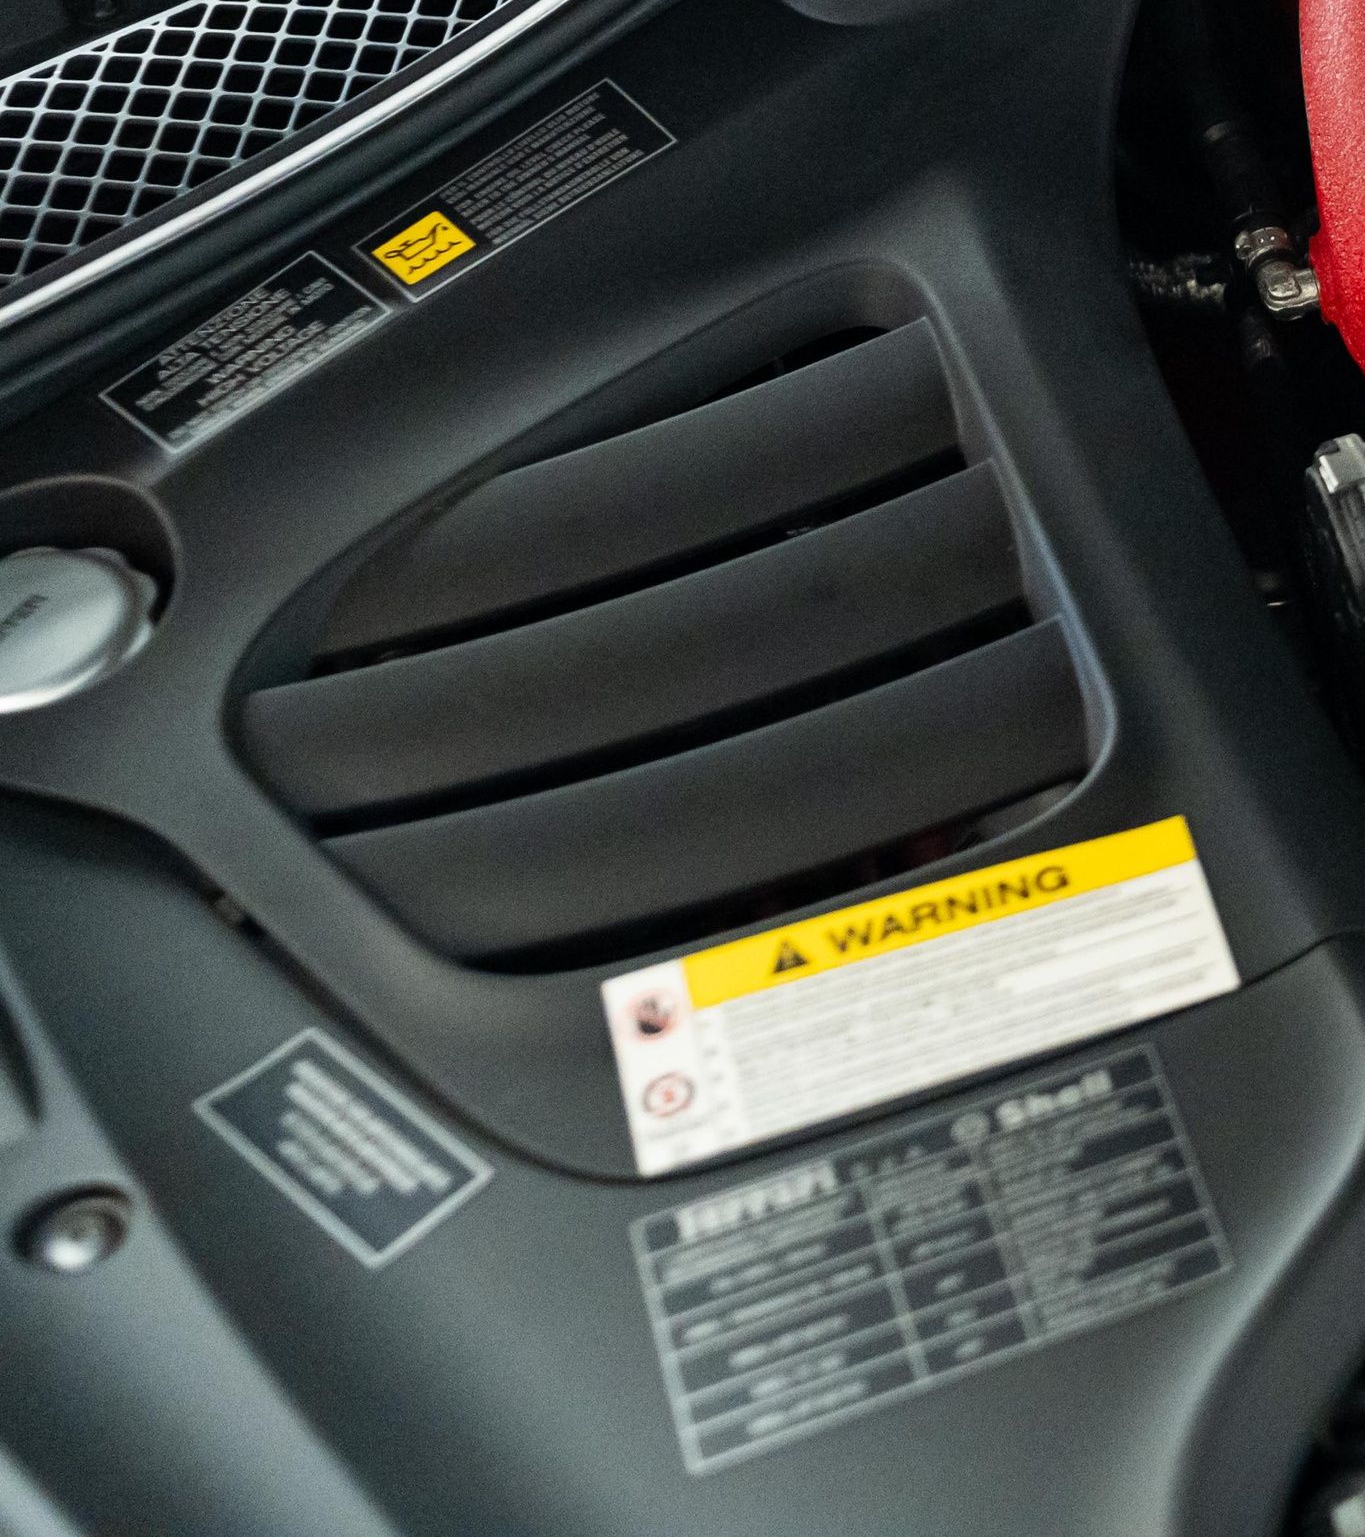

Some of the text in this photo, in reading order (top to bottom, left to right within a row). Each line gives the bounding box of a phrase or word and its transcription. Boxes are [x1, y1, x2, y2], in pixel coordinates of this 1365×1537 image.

[566, 93, 600, 115] MOTORE
[154, 288, 268, 365] ATTENZIONE
[158, 289, 289, 380] ALTA TENSIONE
[196, 320, 325, 406] HIGH VOLTAGE
[207, 326, 295, 383] WARNING
[827, 865, 1070, 952] WARNING
